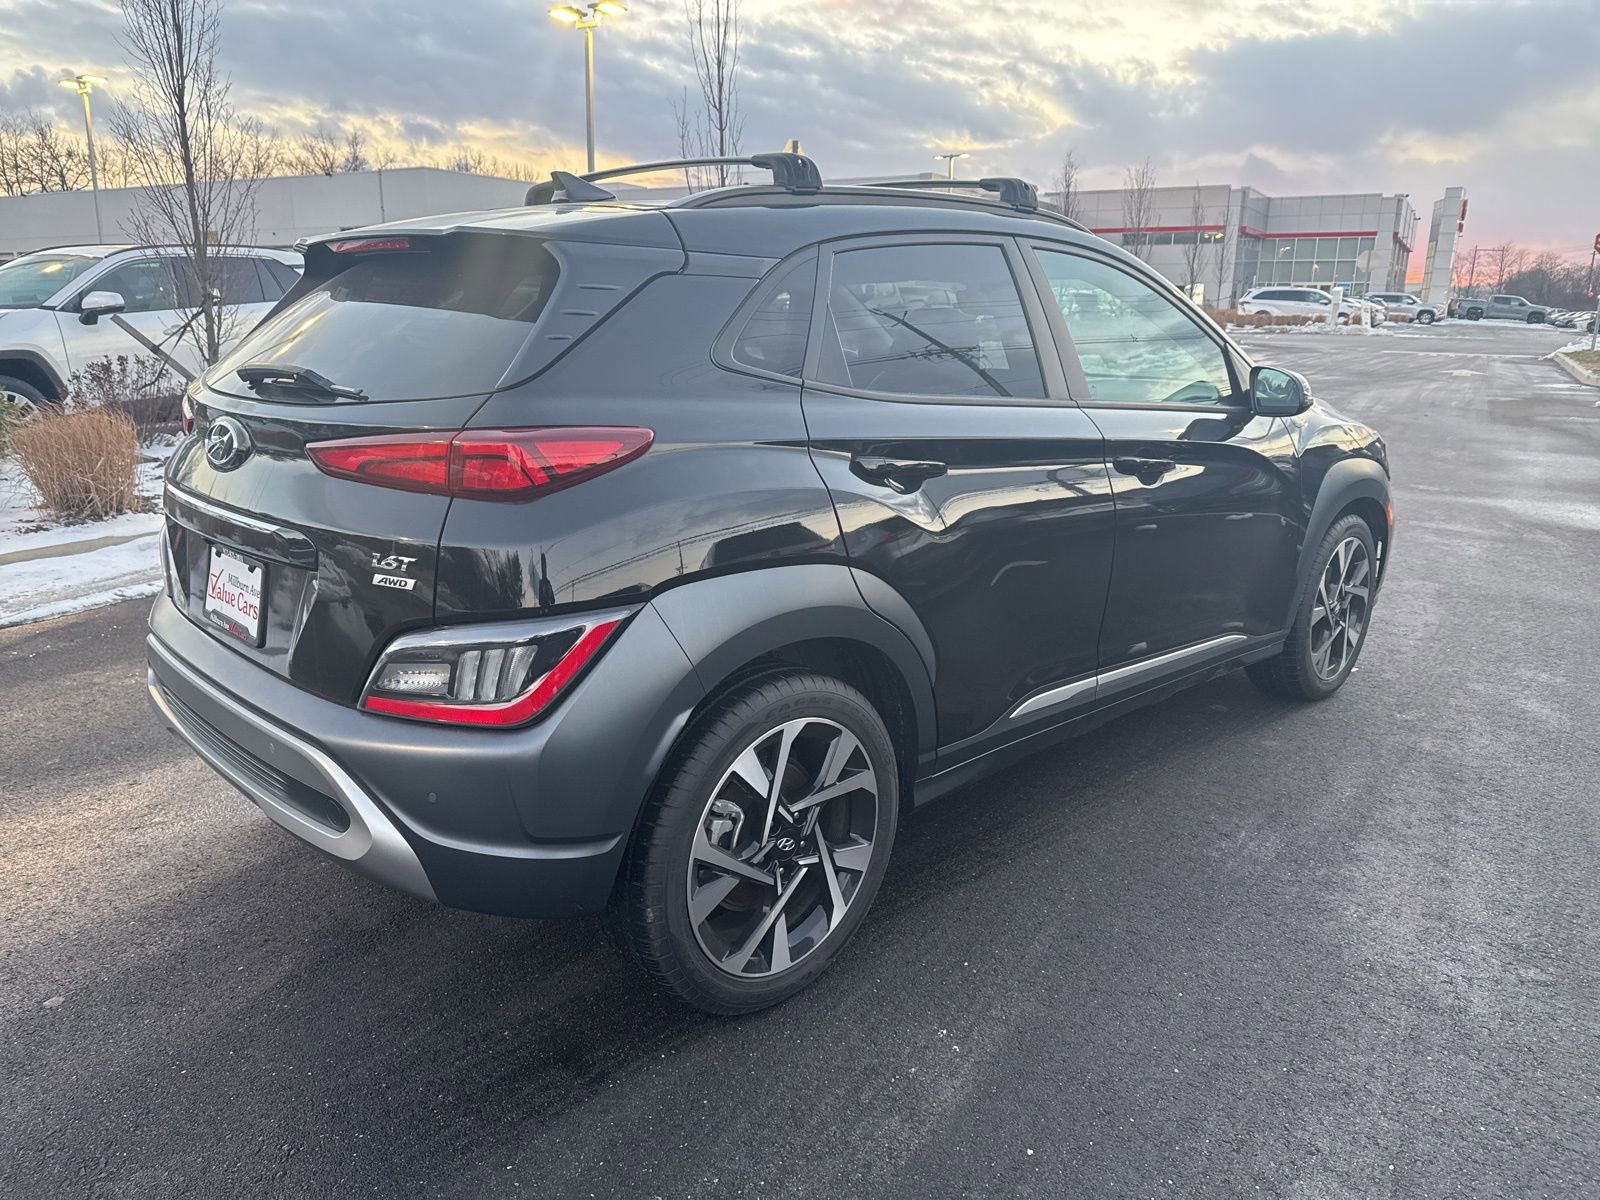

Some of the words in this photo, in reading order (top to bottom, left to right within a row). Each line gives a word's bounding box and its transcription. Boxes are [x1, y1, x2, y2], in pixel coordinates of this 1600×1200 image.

[377, 576, 408, 588] AWD
[208, 568, 236, 608] Value
[237, 592, 259, 621] Cars
[249, 585, 261, 599] Ave
